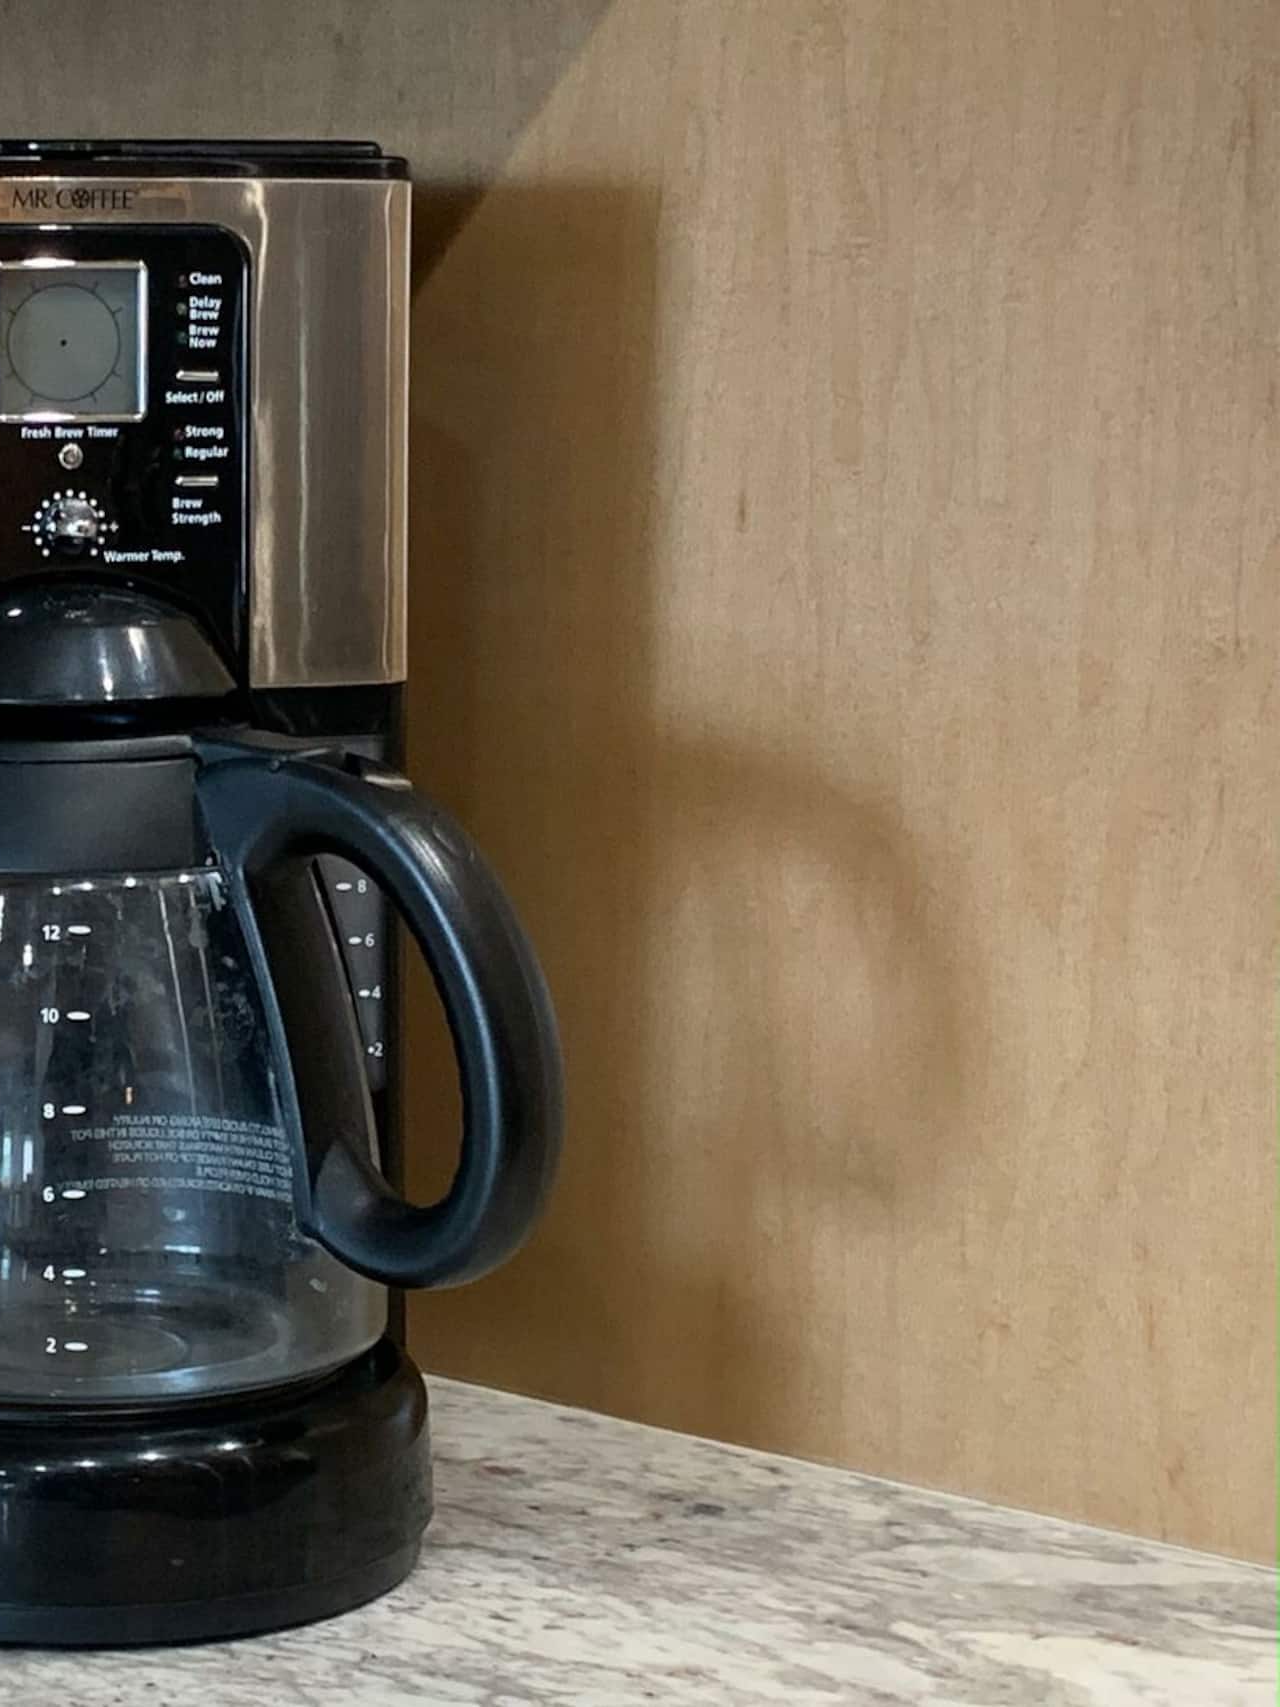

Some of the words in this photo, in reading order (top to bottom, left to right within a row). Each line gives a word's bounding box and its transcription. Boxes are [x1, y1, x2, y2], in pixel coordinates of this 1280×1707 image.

[55, 187, 133, 210] COFFEE
[188, 272, 223, 286] Clean
[189, 295, 222, 312] Delay
[189, 308, 220, 321] Brew
[188, 323, 220, 337] Brew
[188, 336, 217, 349] Now
[165, 391, 199, 404] Select
[205, 390, 225, 404] Off
[20, 425, 52, 439] Fresh
[54, 426, 85, 439] Brew
[86, 425, 119, 438] Timer
[184, 425, 225, 440] Strong
[184, 445, 229, 461] Regular
[171, 497, 203, 510] Brew
[171, 511, 222, 526] Strength
[103, 550, 150, 563] Warmer
[150, 549, 185, 563] Temp.
[357, 878, 367, 894] 8
[42, 924, 61, 941] 12
[364, 932, 375, 948] 6
[371, 985, 381, 999] 4
[40, 1007, 60, 1024] 10
[373, 1041, 383, 1057] 2
[43, 1102, 55, 1119] 8
[42, 1186, 55, 1203] 6
[43, 1264, 55, 1281] 4
[45, 1337, 57, 1354] 2
